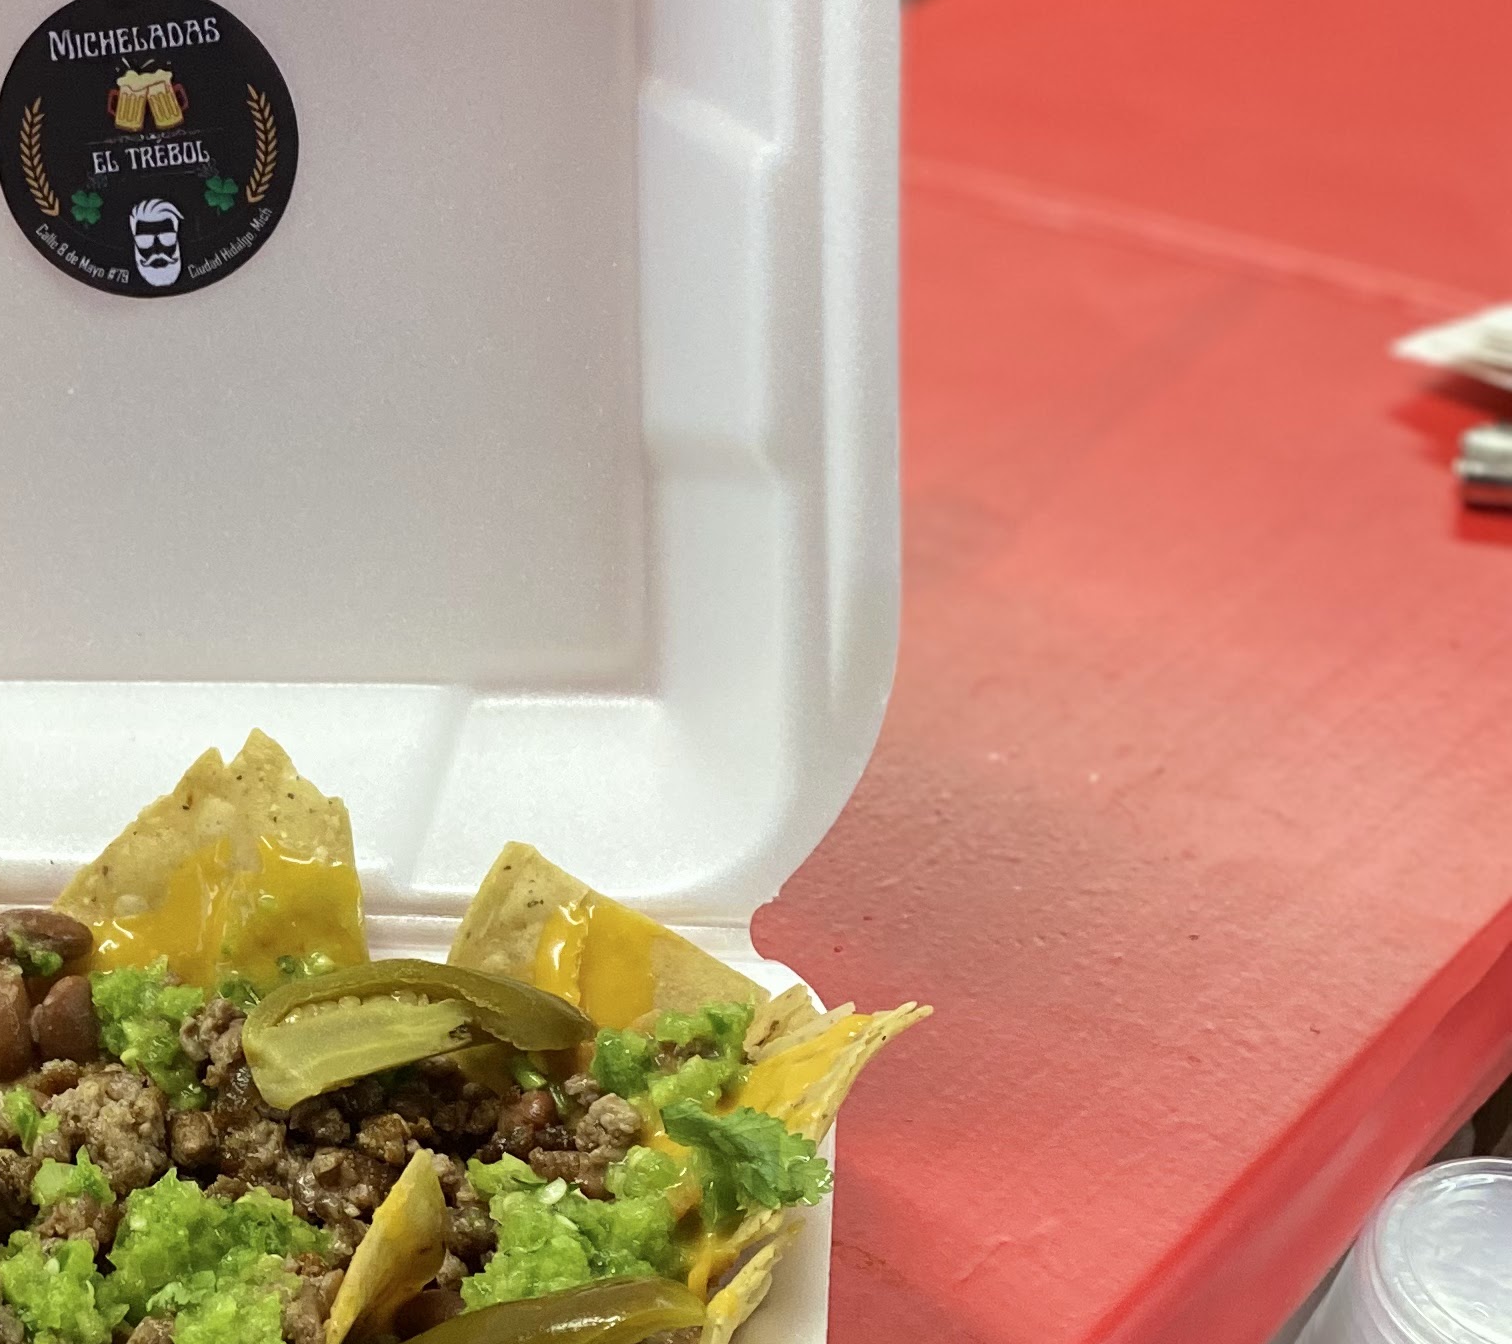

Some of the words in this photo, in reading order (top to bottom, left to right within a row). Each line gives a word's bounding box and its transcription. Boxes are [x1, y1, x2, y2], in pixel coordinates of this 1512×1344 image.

[48, 17, 221, 62] MICHELADAS
[92, 151, 120, 175] EL
[65, 250, 79, 266] de
[78, 256, 105, 278] Mayo
[188, 252, 223, 278] Ciudad
